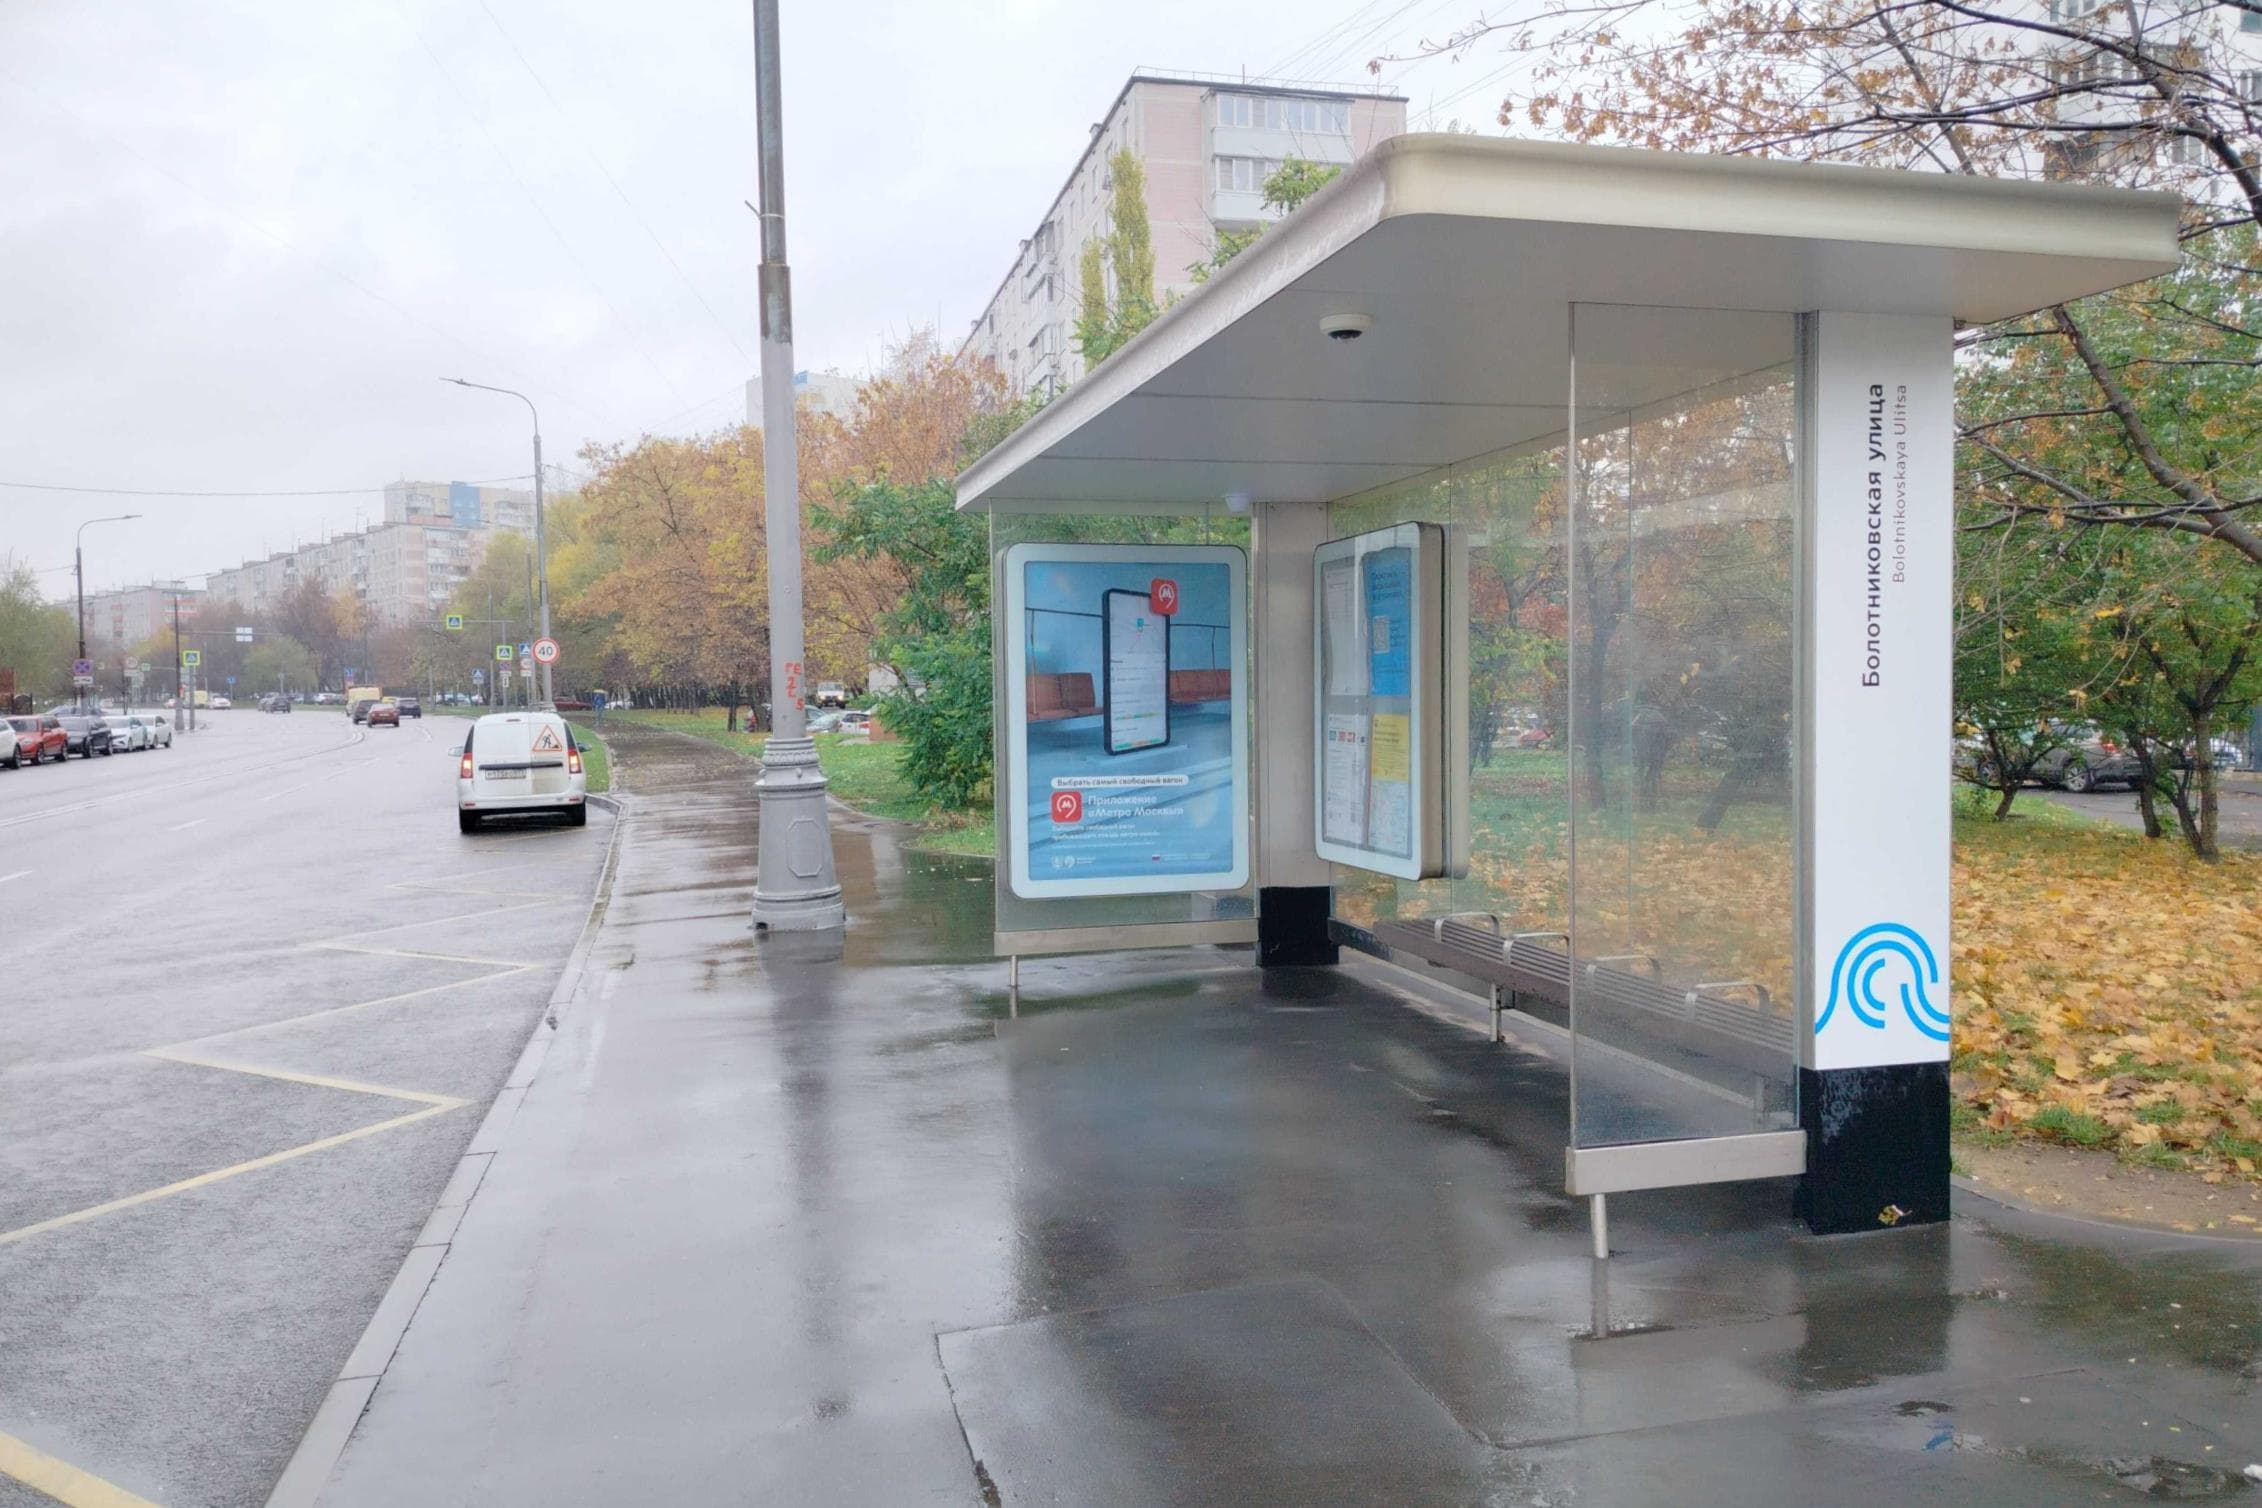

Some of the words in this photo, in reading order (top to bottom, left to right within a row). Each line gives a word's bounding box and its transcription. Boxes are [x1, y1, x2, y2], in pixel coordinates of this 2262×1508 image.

[1869, 384, 1886, 461] улица
[1893, 385, 1907, 435] Ulitsa
[1892, 441, 1908, 583] Bolotnikovskaya
[1862, 471, 1882, 687] Болотниковская
[538, 646, 553, 656] 40
[1057, 778, 1090, 787] Выбрать
[1093, 777, 1117, 785] самый
[1087, 795, 1157, 806] Приложение
